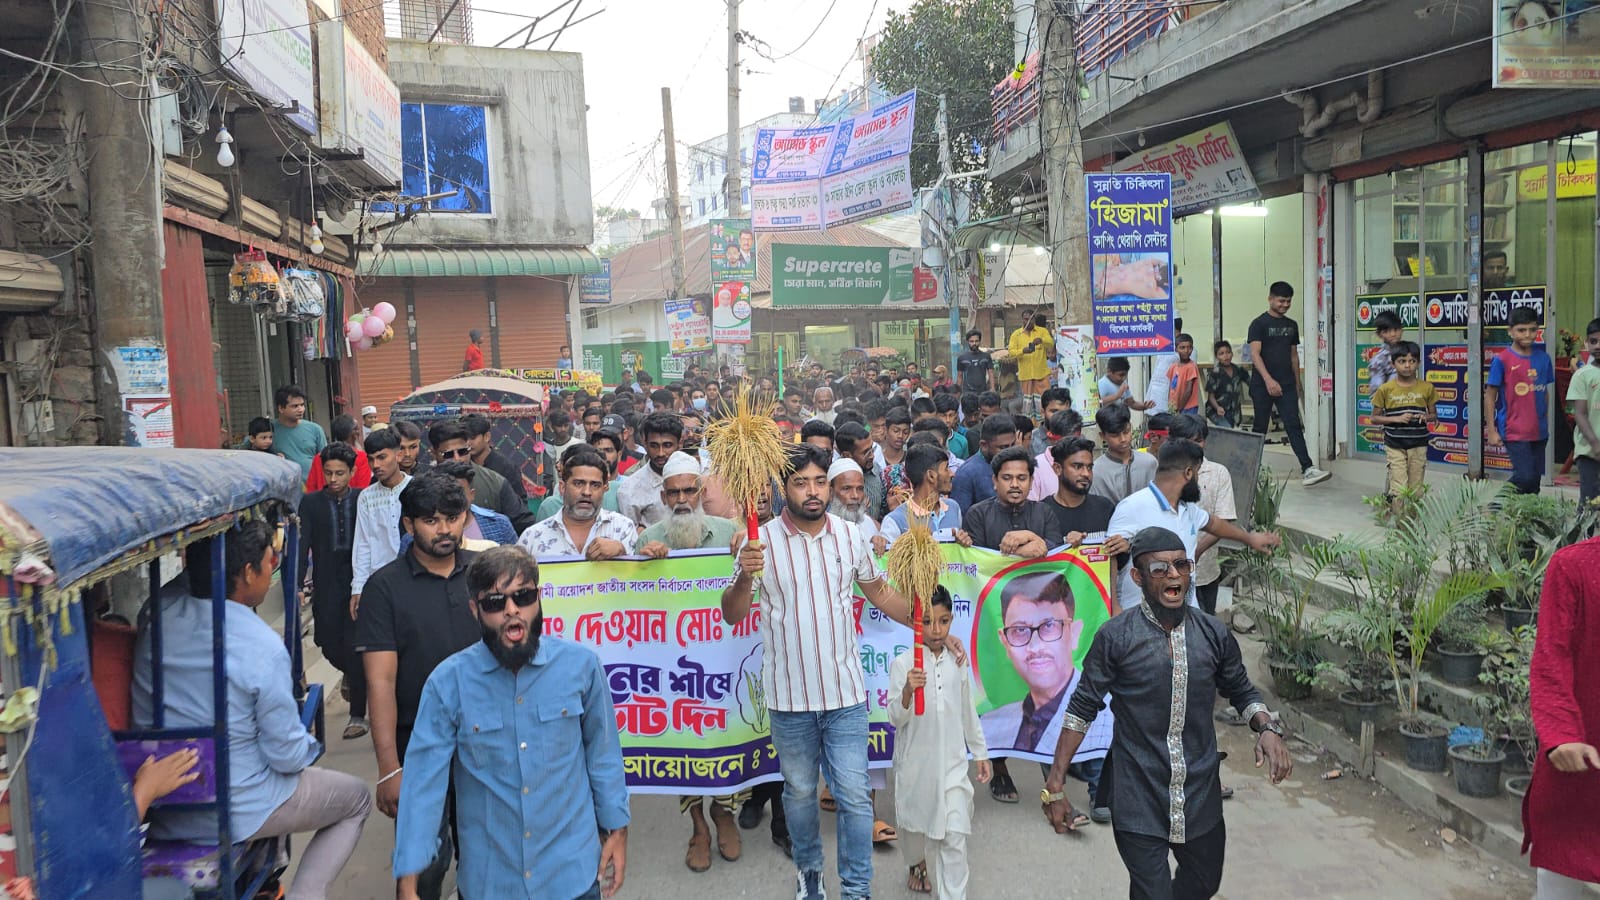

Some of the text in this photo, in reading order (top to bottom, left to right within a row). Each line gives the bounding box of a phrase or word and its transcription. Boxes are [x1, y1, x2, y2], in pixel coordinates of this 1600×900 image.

[1125, 176, 1165, 191] চিকিৎসা
[784, 256, 882, 277] Supercrete
[558, 584, 594, 598] ত্রয়োদশ
[597, 578, 626, 594] জাতীয়
[630, 581, 655, 593] সংসদ
[658, 578, 693, 594] নির্বাচনে
[696, 576, 730, 591] বাংলাদে
[574, 609, 667, 648] দেওয়ান
[676, 607, 723, 648] মোঃ
[669, 655, 735, 701] শীষে
[672, 698, 729, 737] দিন
[623, 752, 746, 780] আয়োজনে
